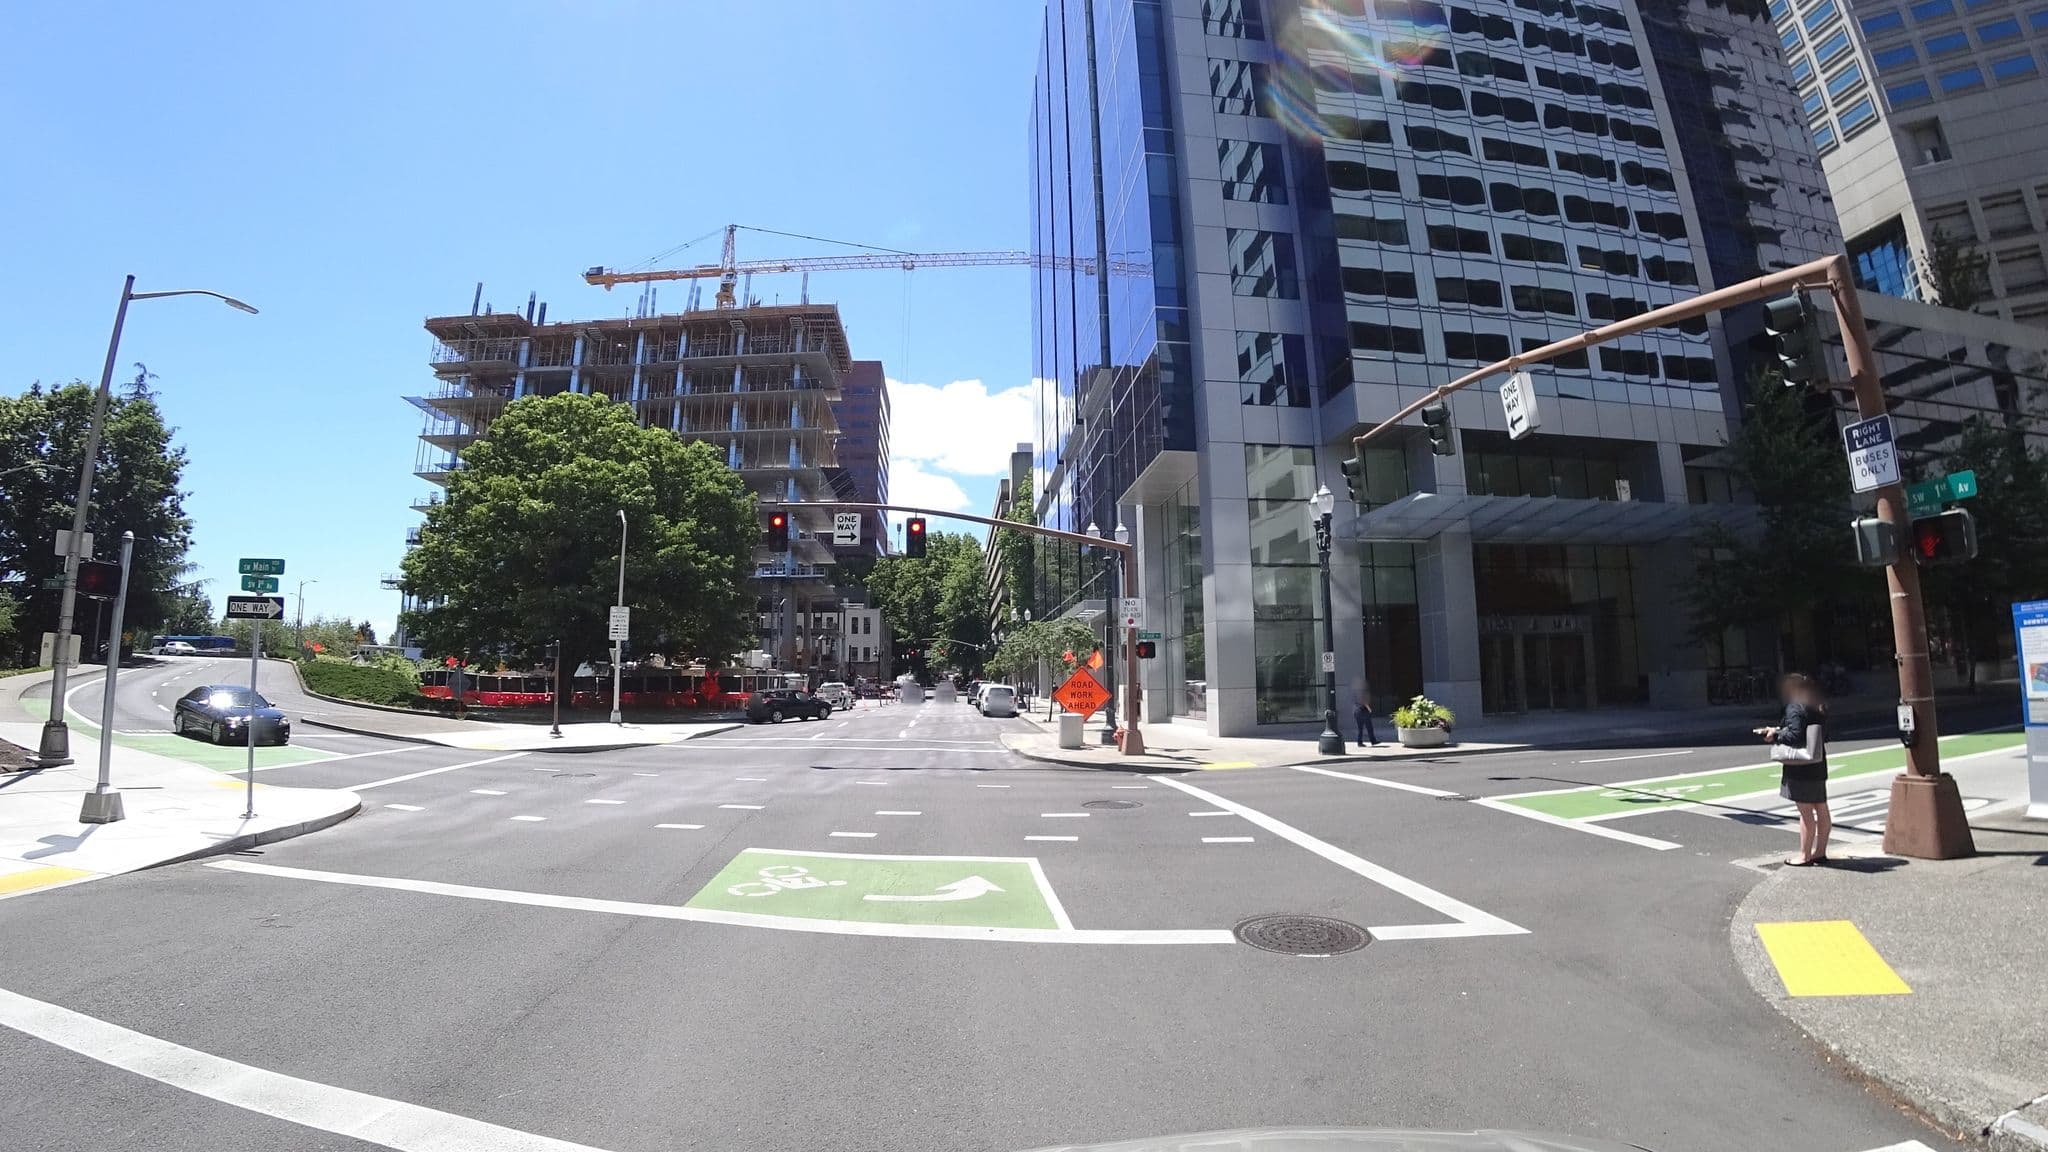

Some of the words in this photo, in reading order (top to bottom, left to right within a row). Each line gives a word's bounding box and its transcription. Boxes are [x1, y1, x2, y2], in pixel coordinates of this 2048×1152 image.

[1503, 381, 1517, 400] ONE
[1506, 395, 1520, 413] WAY
[1852, 422, 1881, 439] RIGHT
[1855, 433, 1882, 448] LANE
[1855, 449, 1889, 466] BUSES
[1861, 463, 1887, 478] ONLY
[1912, 492, 1925, 504] SW
[837, 515, 857, 523] ONE
[837, 523, 857, 531] WAY
[253, 561, 270, 571] Main
[231, 602, 247, 612] ONE
[252, 603, 269, 613] WAY
[1071, 681, 1094, 689] ROAD
[1070, 691, 1094, 699] WORK
[1068, 701, 1096, 709] AHEAD
